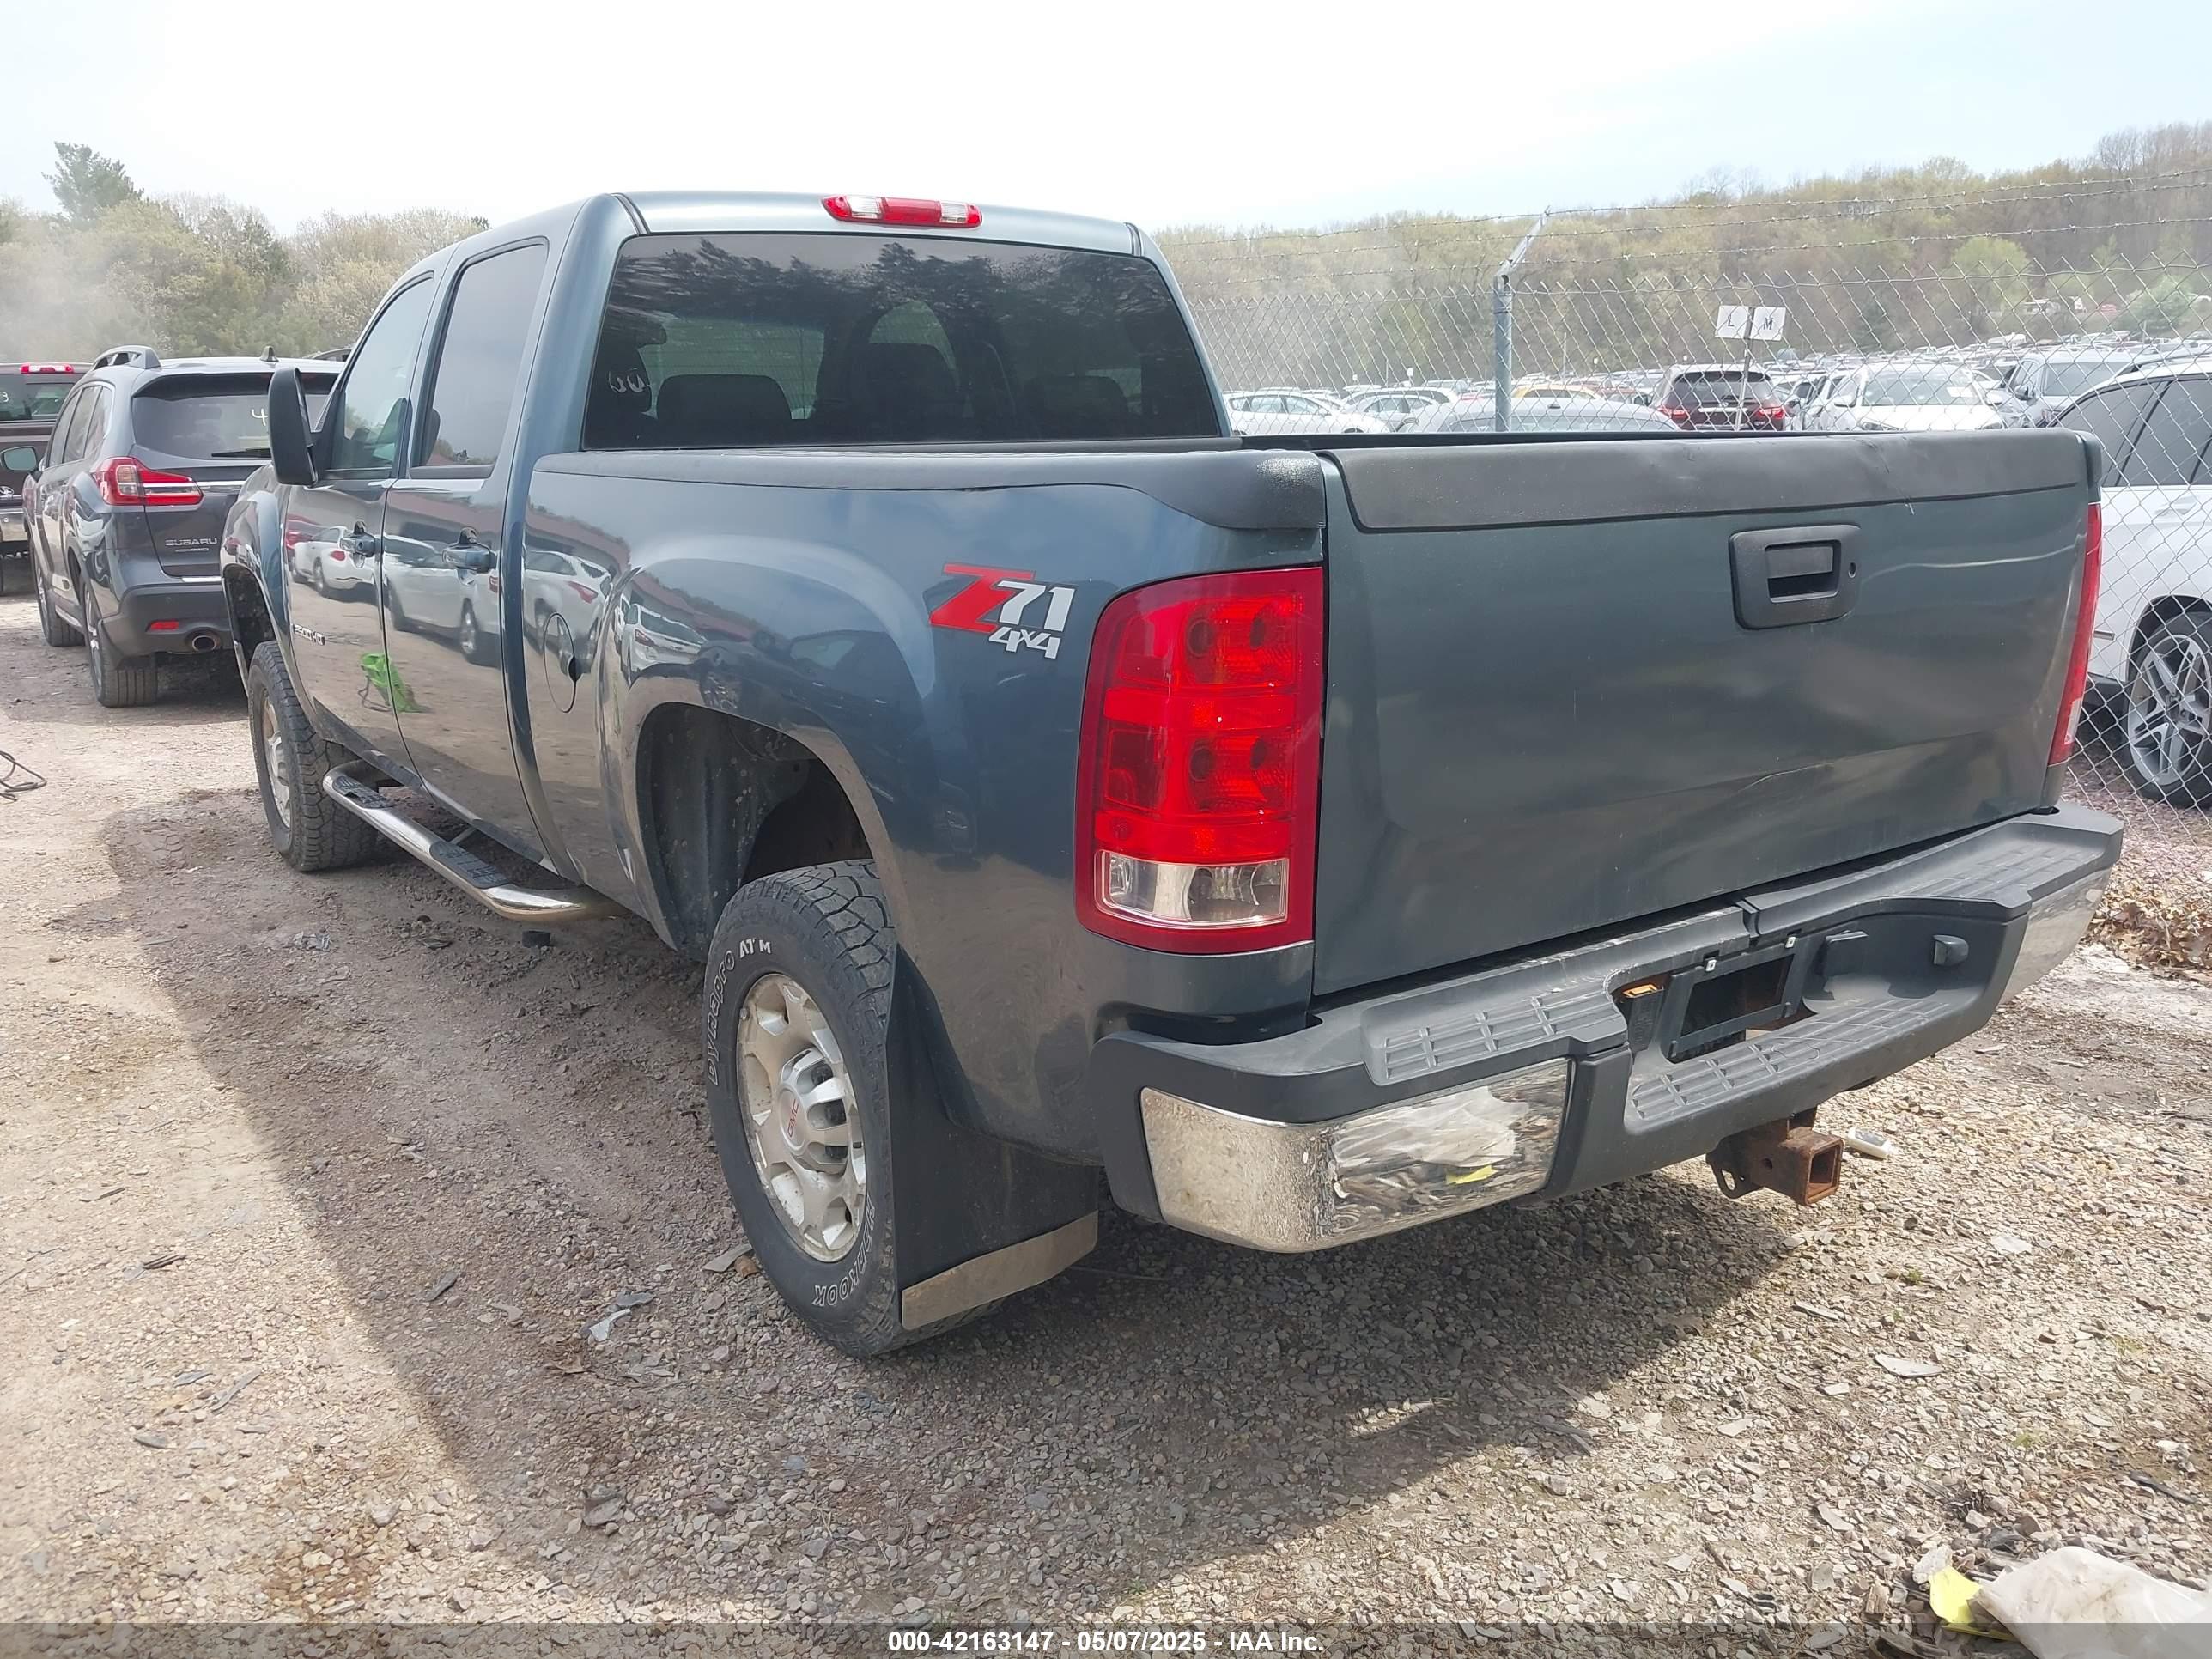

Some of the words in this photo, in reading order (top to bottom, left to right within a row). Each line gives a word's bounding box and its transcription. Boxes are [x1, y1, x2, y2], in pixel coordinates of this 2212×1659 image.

[1763, 317, 1773, 330] M
[251, 408, 268, 427] 4
[165, 538, 217, 546] SUBARU
[929, 563, 1076, 634] Z71
[787, 1098, 799, 1138] GMC
